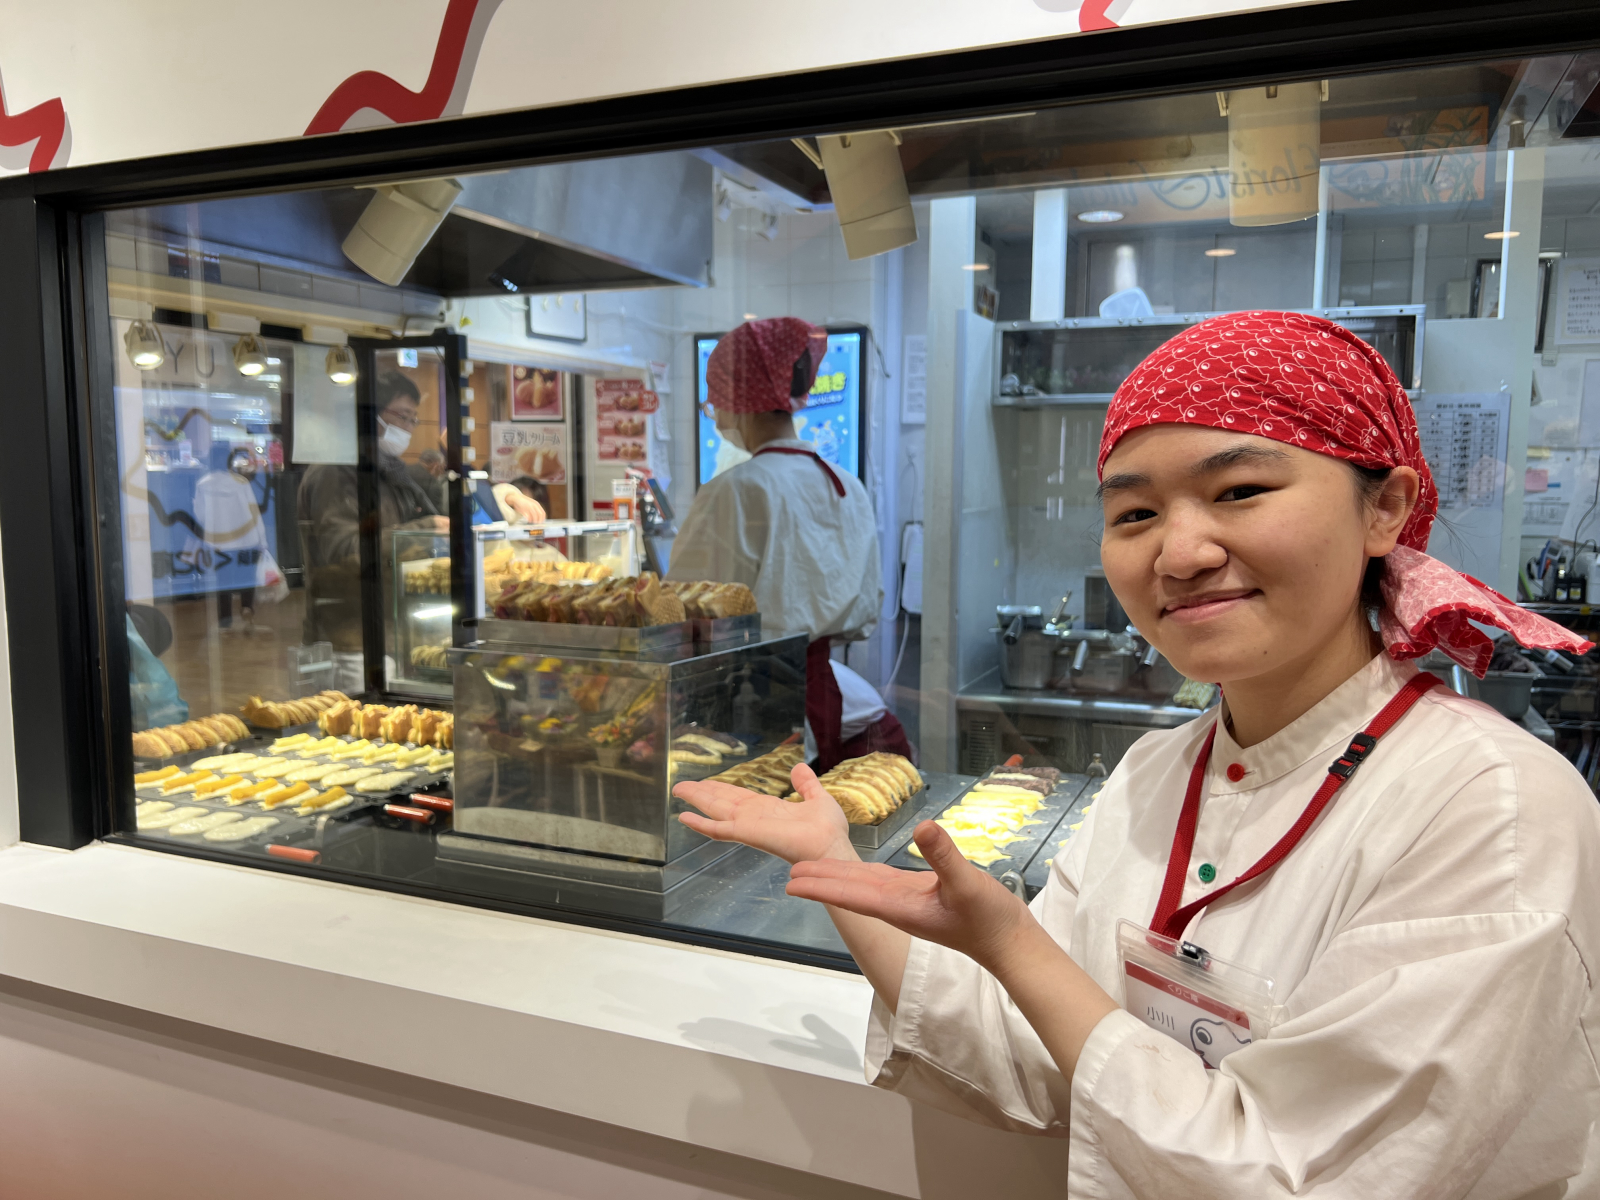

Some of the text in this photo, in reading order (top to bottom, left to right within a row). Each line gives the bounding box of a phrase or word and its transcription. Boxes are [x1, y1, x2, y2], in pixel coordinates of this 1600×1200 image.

[502, 431, 561, 446] 豆乳クリーム
[1146, 1006, 1175, 1031] 小川
